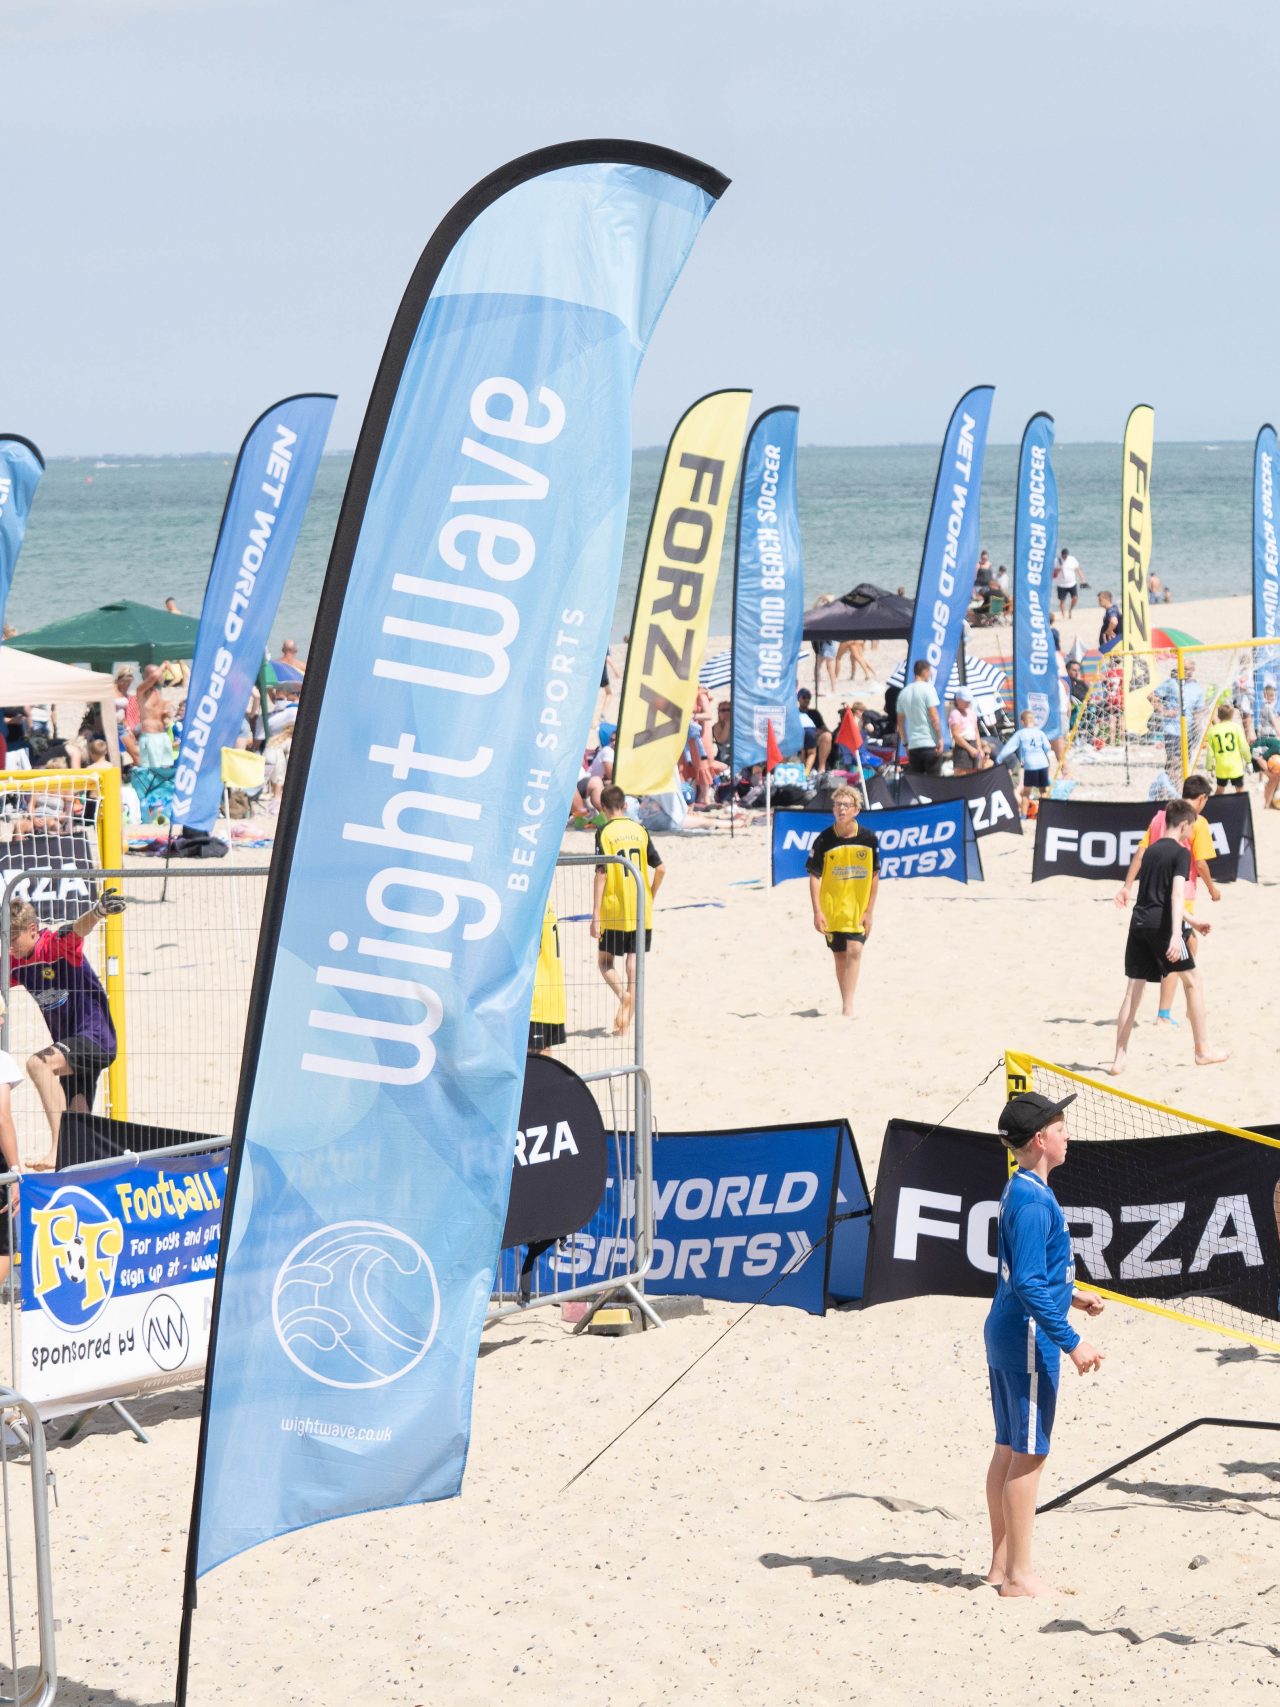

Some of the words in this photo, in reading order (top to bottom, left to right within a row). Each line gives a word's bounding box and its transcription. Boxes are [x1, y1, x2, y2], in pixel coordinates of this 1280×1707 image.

[261, 424, 298, 508] NET
[955, 411, 977, 483] NET
[1029, 445, 1047, 518] SOCCER
[757, 443, 781, 525] SOCCER
[1260, 451, 1274, 519] SOCCER
[372, 376, 567, 696] Wave
[757, 527, 786, 591] BEACH
[938, 486, 969, 598] WORLD
[1027, 522, 1046, 589] BEACH
[1262, 520, 1280, 577] BEACH
[225, 509, 276, 643] WORLD
[633, 451, 726, 750] FORZA
[757, 596, 785, 690] ENGLAND
[927, 598, 950, 684] SPO
[1030, 591, 1048, 676] ENGLAND
[174, 644, 235, 797] SPORTS
[506, 768, 551, 893] BEACH
[535, 607, 585, 751] SPORTS
[1214, 732, 1235, 753] 13
[1045, 827, 1231, 866] FORA
[2, 863, 89, 903] RZA
[300, 733, 502, 1086] Wight
[512, 1120, 579, 1167] RZA
[116, 1170, 221, 1224] Football
[120, 1268, 145, 1288] sign
[148, 1264, 163, 1283] up
[167, 1257, 181, 1277] at
[130, 1238, 152, 1256] For
[155, 1231, 181, 1255] boys
[184, 1227, 202, 1246] and
[203, 1223, 221, 1246] girl
[548, 1231, 783, 1280] SPORTS
[31, 1332, 111, 1371] sponsored
[118, 1327, 135, 1356] by
[281, 1416, 393, 1441] wightwave.co.uk
